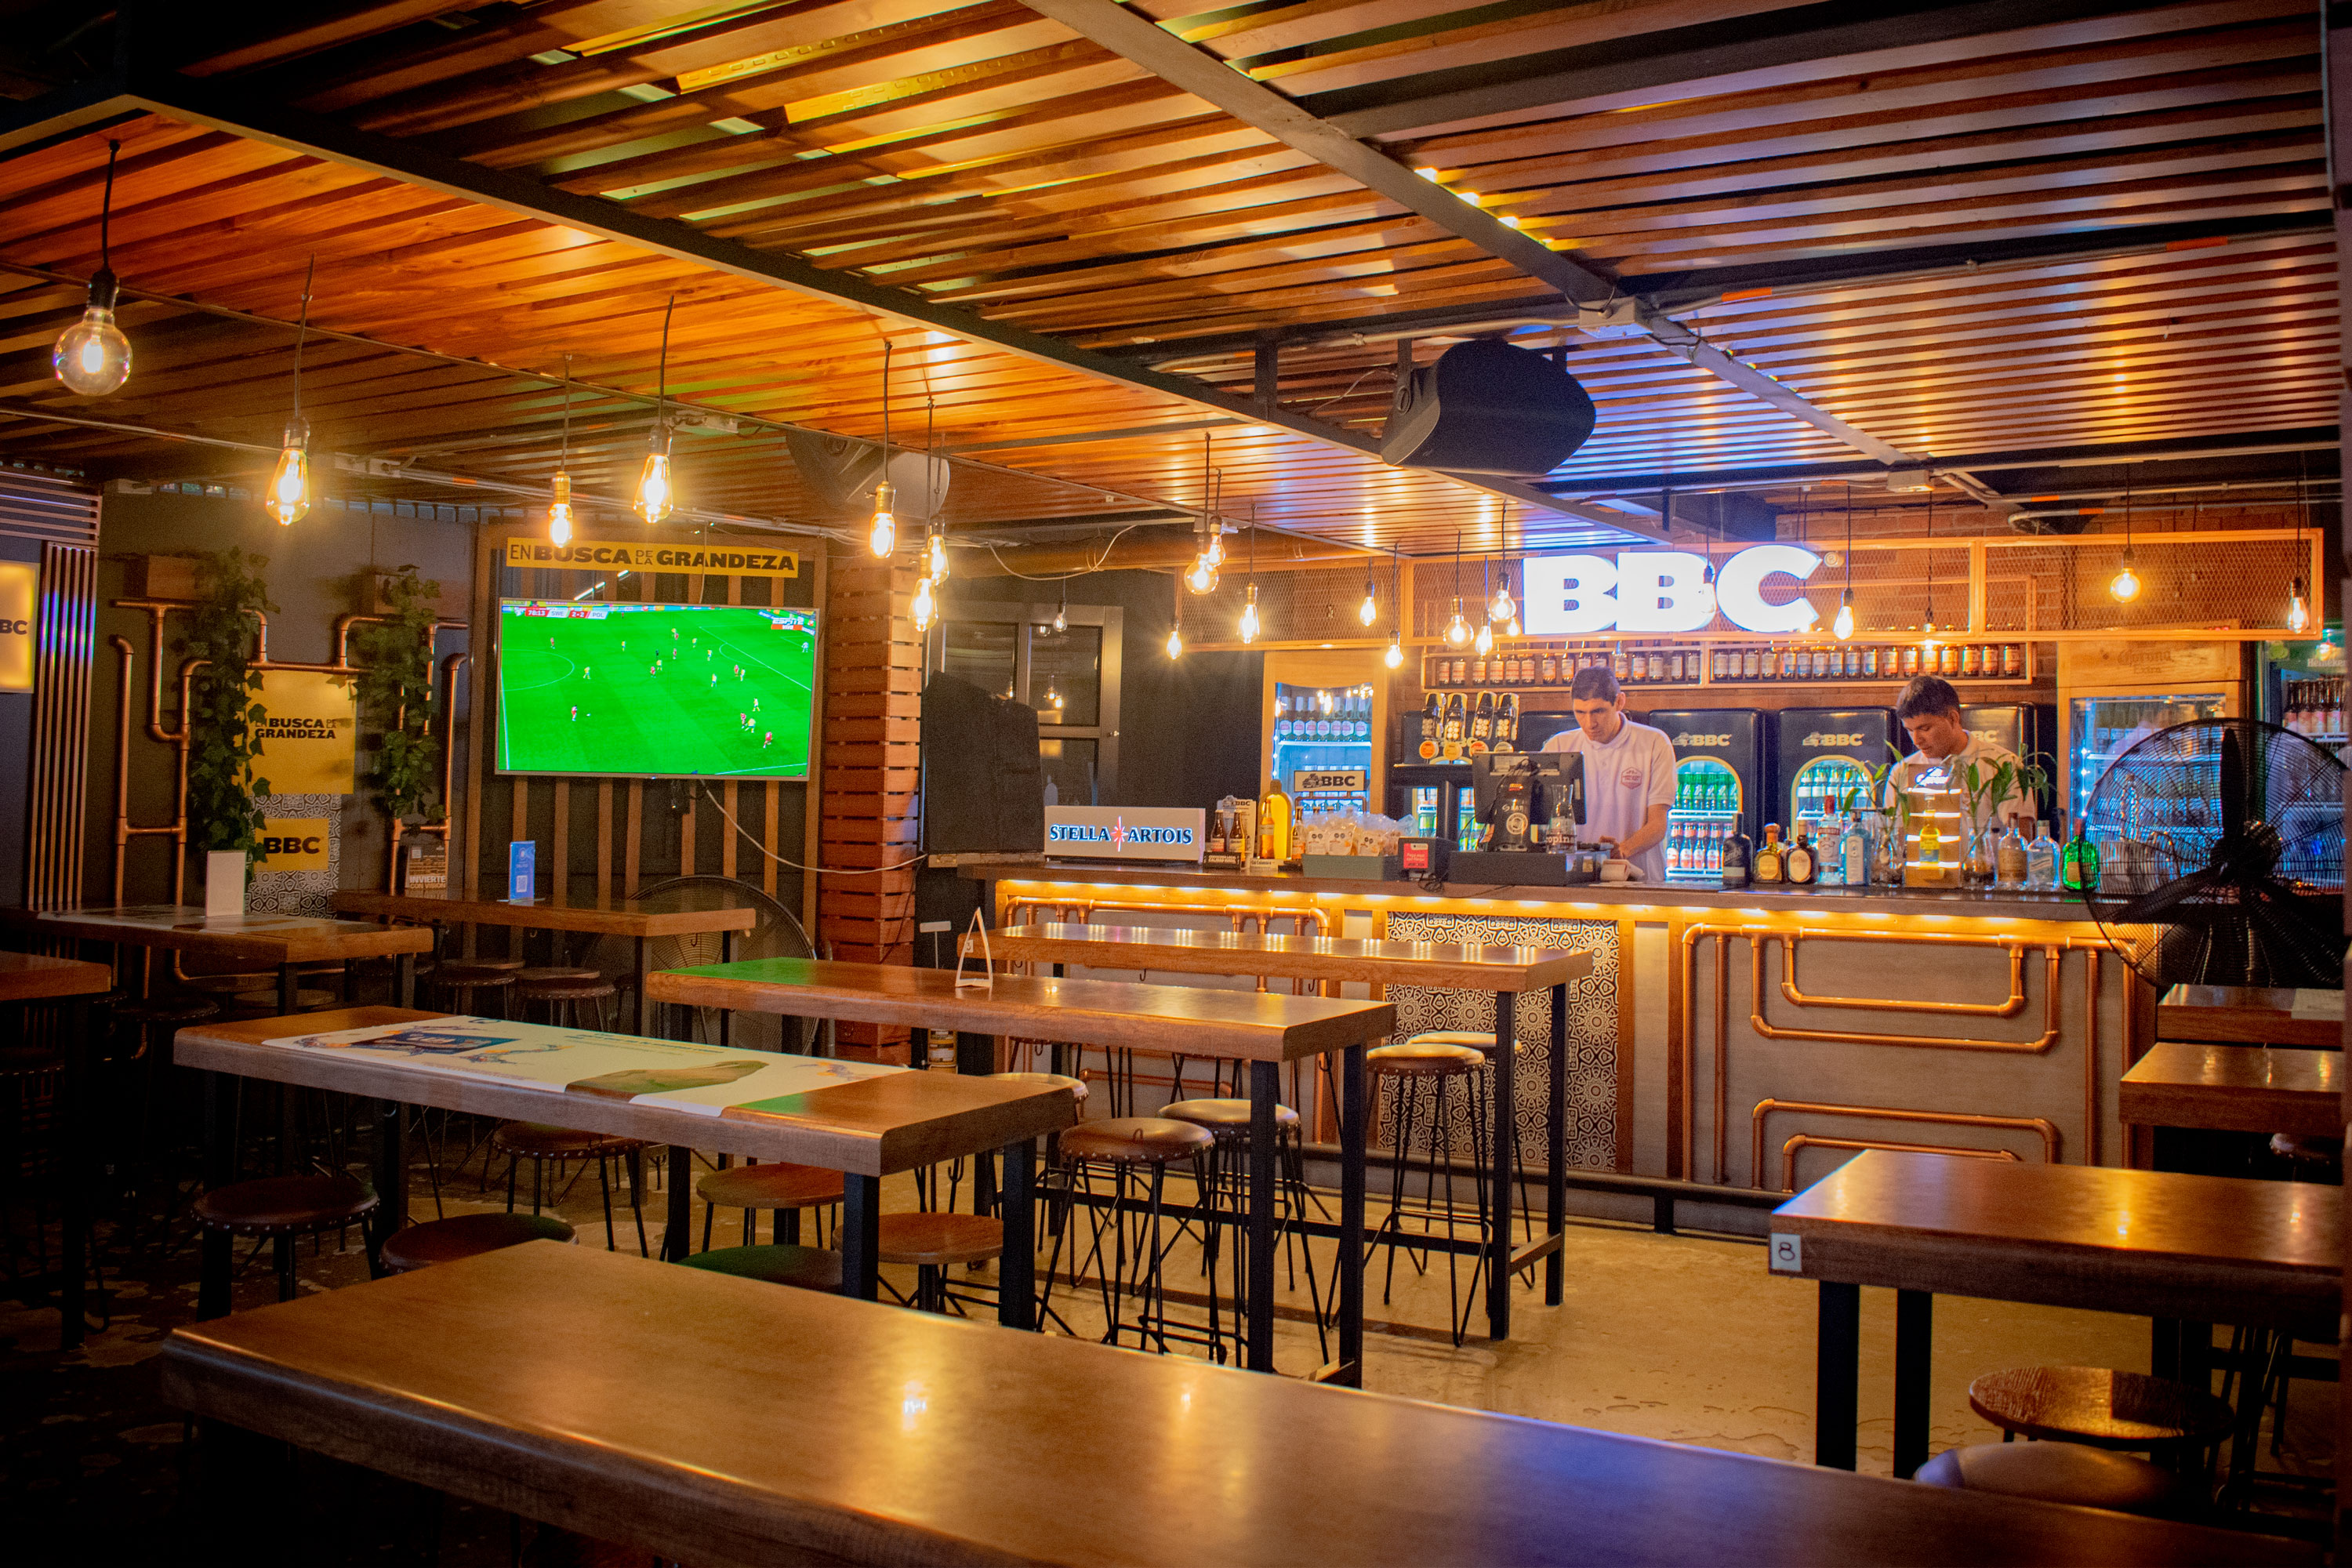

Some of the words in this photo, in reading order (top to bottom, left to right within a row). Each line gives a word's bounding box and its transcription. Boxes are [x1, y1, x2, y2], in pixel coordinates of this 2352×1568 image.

[510, 544, 531, 560] EN
[534, 546, 632, 564] BUSCA
[656, 550, 795, 571] GRANDEZA
[1523, 544, 1823, 634] BBC
[269, 717, 325, 728] BUSCA
[255, 728, 336, 739] GRANDEZA
[1692, 734, 1730, 746] BBC
[1824, 733, 1863, 746] BBC
[1321, 775, 1356, 786] BBC
[1050, 824, 1112, 841] STELLA
[1127, 826, 1193, 845] ARTOIS
[263, 837, 321, 854] BBC
